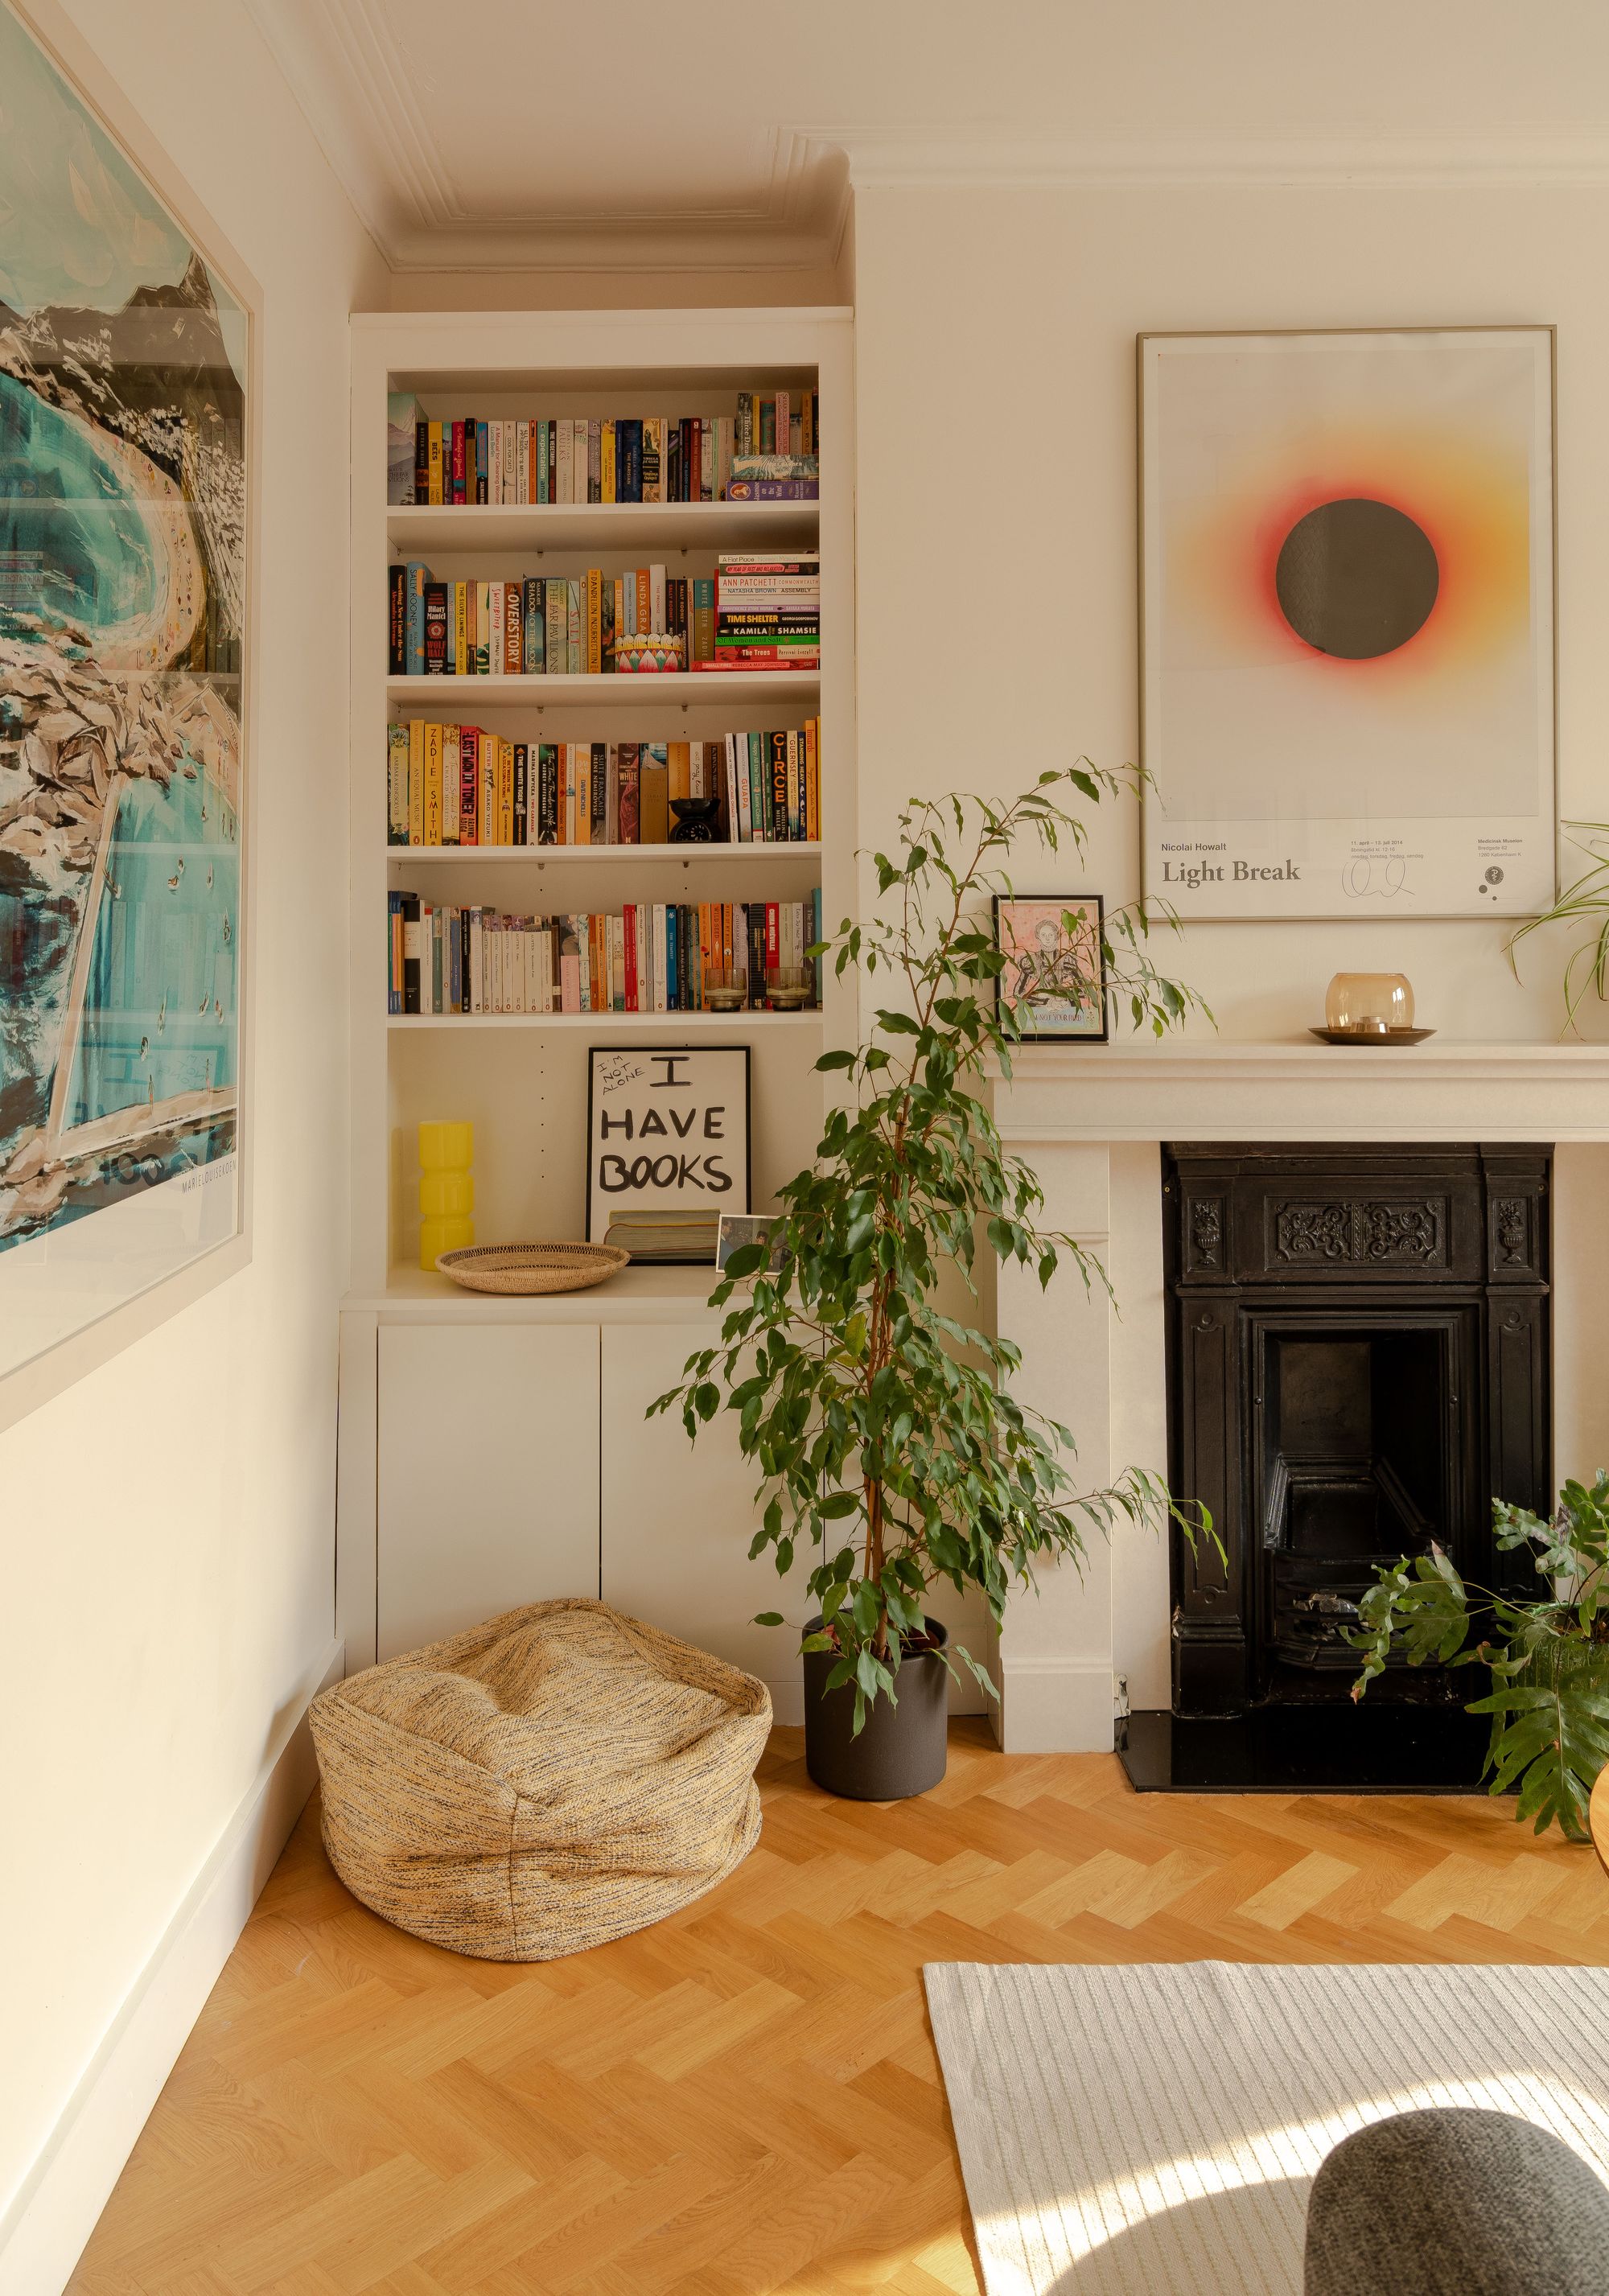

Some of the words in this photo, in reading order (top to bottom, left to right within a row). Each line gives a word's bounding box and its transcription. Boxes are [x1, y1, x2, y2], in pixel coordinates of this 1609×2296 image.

[539, 434, 547, 479] expectation
[428, 605, 446, 614] Hilary
[492, 588, 501, 630] SWEETBITTER
[529, 618, 536, 627] OF
[549, 605, 558, 623] FAR
[726, 615, 747, 623] TIME
[747, 615, 779, 623] SHELTER
[508, 594, 520, 664] OVERSTORY
[570, 611, 579, 644] SALT
[549, 623, 558, 673] PAVILIONS
[462, 734, 475, 756] LAST
[807, 729, 815, 753] Innards
[462, 756, 475, 772] MAN
[619, 772, 638, 781] WHITE
[773, 733, 786, 803] CIRCE
[462, 773, 475, 784] IN
[461, 786, 475, 814] TOWER
[429, 790, 438, 839] SMITH
[1161, 843, 1192, 851] Nicolai
[1195, 842, 1227, 851] Howalt
[1162, 859, 1224, 889] Light
[1232, 858, 1302, 882] Break
[596, 1055, 624, 1073] I'M
[603, 1062, 632, 1084] NOT
[649, 1055, 693, 1088] I
[603, 1067, 647, 1096] ALONE
[600, 1106, 726, 1141] HAVE
[599, 1154, 733, 1193] BOOKS
